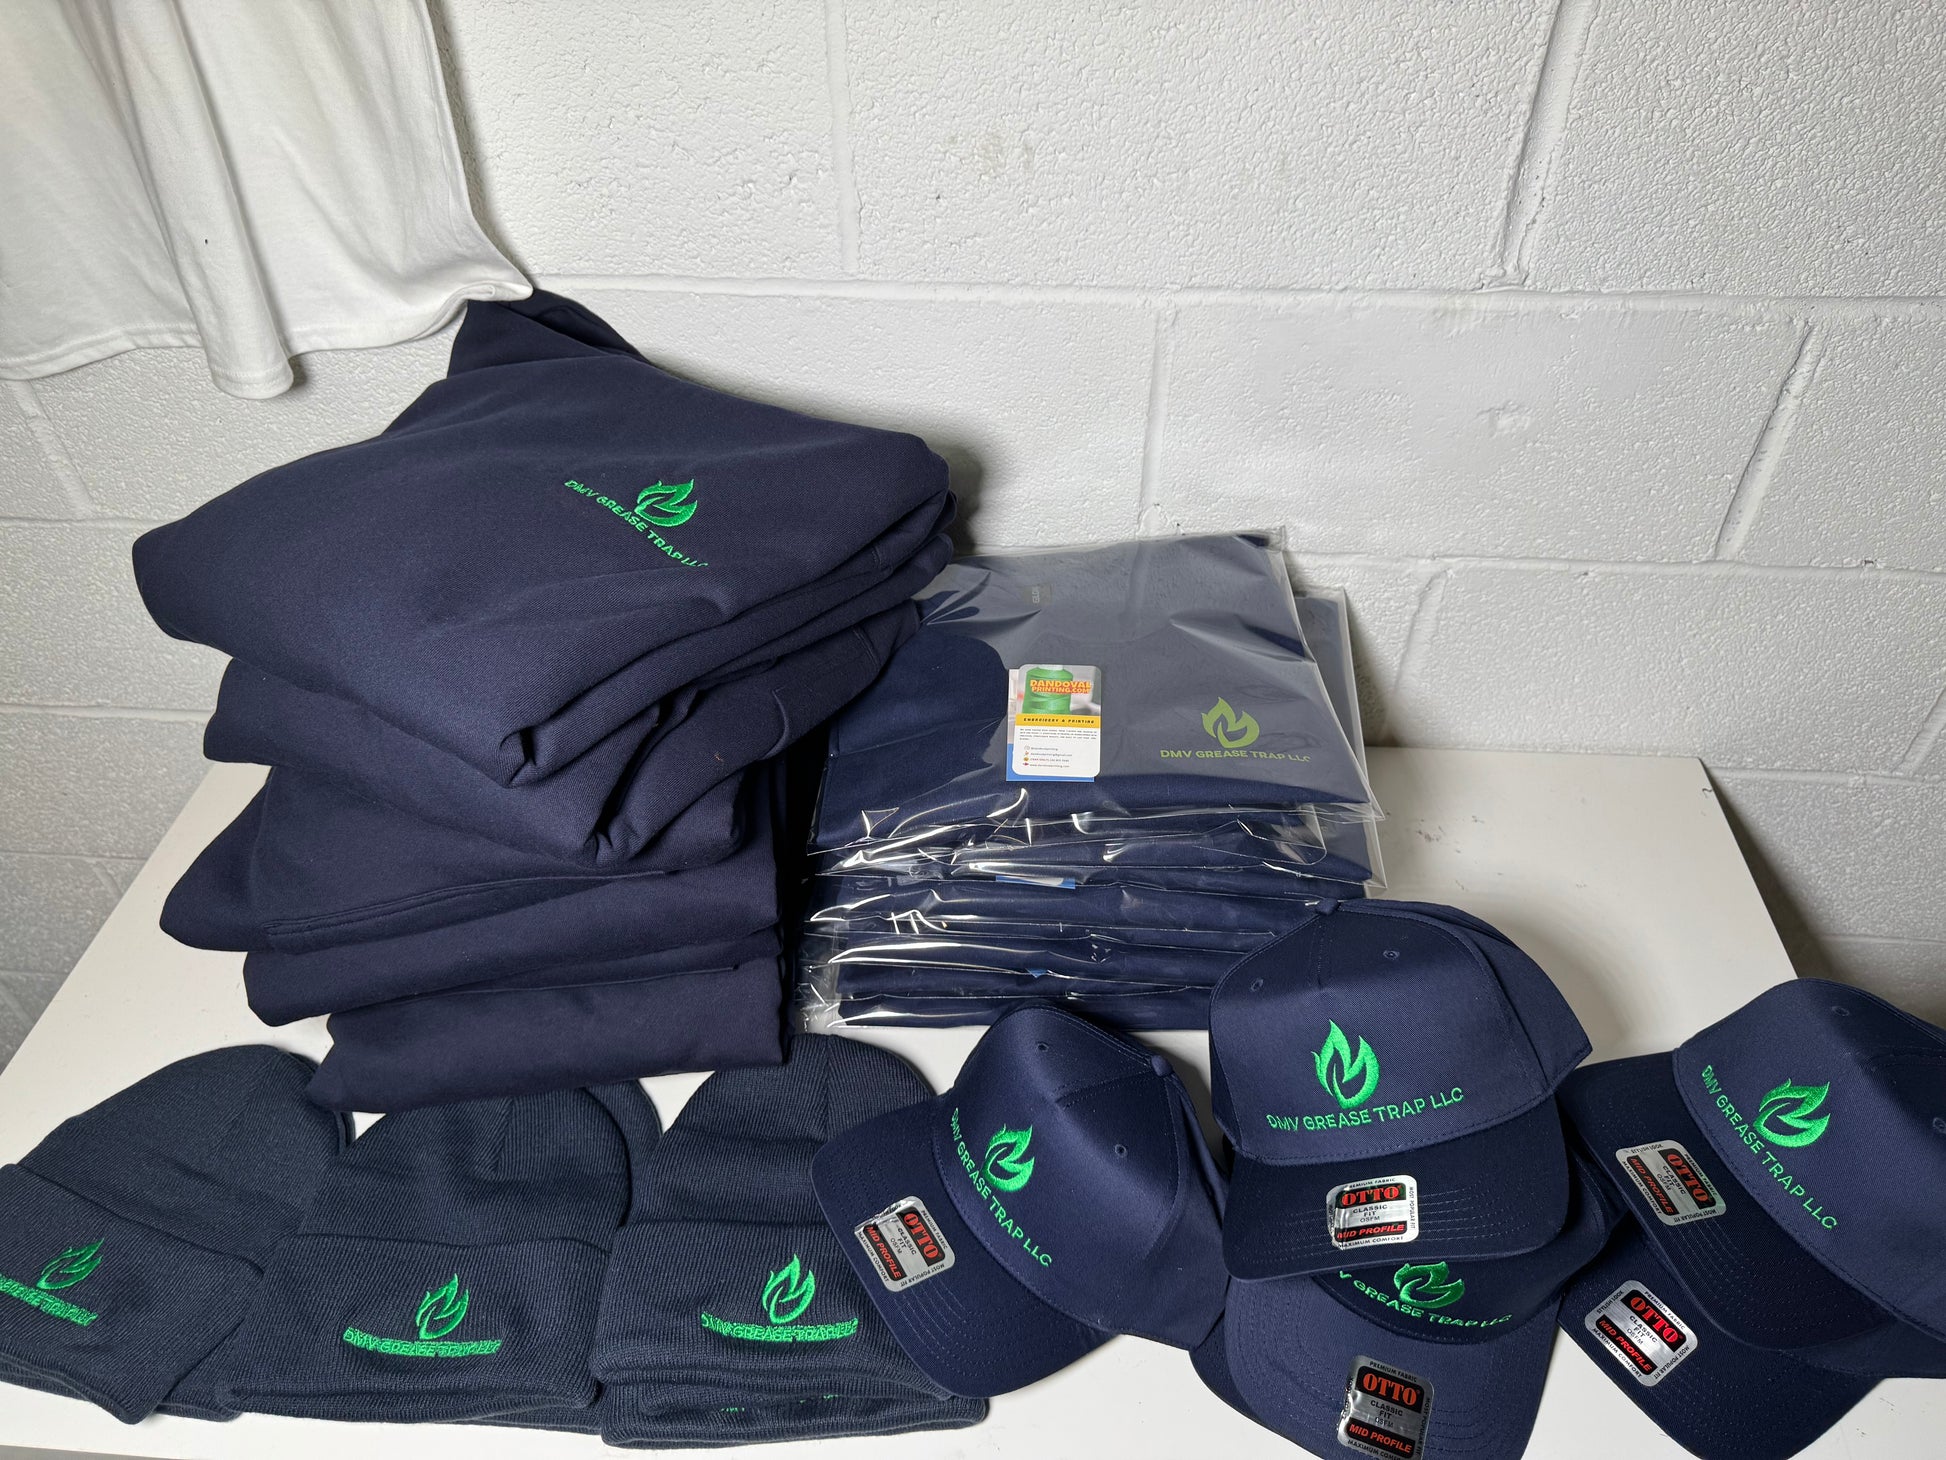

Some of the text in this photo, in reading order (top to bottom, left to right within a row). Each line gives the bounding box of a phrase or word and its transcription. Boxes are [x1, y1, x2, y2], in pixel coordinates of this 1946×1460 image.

[564, 480, 599, 498] DMV
[596, 496, 648, 532] GREASE
[647, 530, 683, 560] TRAP
[1031, 686, 1091, 694] PRINTING.COM
[1160, 750, 1192, 758] DMV
[1195, 750, 1248, 759] GREASE
[1250, 751, 1286, 760] TRAP
[1266, 1087, 1464, 1131] DMV GREASE TRAP LLC
[1701, 1064, 1838, 1230] DMV GREASE TRAP LLC
[1622, 1161, 1662, 1214] MAXIMUM COMFORT
[1630, 1158, 1674, 1213] MID PROFILE
[1656, 1173, 1671, 1191] OSFM
[1663, 1165, 1686, 1195] CLASSIC
[1664, 1176, 1676, 1187] FIT
[1667, 1154, 1709, 1202] OTTO
[1684, 1153, 1718, 1196] PREMIUM FABRIC
[957, 1141, 992, 1199] GREASE
[989, 1195, 1024, 1239] TRAP
[1023, 1238, 1052, 1267] LLC
[1341, 1186, 1399, 1206] OTTO
[1352, 1204, 1388, 1214] CLASSIC
[897, 1227, 917, 1255] CLASSIC
[897, 1238, 907, 1249] FIT
[904, 1213, 939, 1258] OTTO
[921, 1209, 948, 1250] PREMIUM FABRIC
[1359, 1224, 1405, 1235] PROFILE
[858, 1231, 890, 1282] MAXIMUM COMFORT
[865, 1226, 881, 1242] MID
[876, 1242, 902, 1279] PROFILE
[890, 1237, 903, 1254] OSFM
[908, 1270, 931, 1284] POPULAR
[931, 1263, 945, 1273] MOST
[1353, 1279, 1425, 1318] GREASE
[1428, 1312, 1479, 1327] TRAP
[1596, 1290, 1624, 1314] STYLISH LOOK
[1644, 1291, 1686, 1330] PREMIUM FABRIC
[1629, 1315, 1658, 1343] CLASSIC
[1630, 1297, 1678, 1343] OTTO
[1633, 1326, 1645, 1337] FIT
[343, 1327, 379, 1350] DMV
[1599, 1320, 1653, 1372] MID PROFILE
[1626, 1328, 1644, 1345] OSFM
[1592, 1328, 1642, 1378] MAXIMUM COMFORT
[1653, 1346, 1690, 1380] MOST POPULAR FIT
[1369, 1361, 1417, 1382] PREMIUM FABRIC
[1363, 1373, 1416, 1405] OTTO
[1370, 1400, 1403, 1416] CLASSIC
[1380, 1410, 1392, 1419] FIT
[1375, 1417, 1394, 1428] OSFM
[1348, 1439, 1379, 1455] MAXIMUM
[1349, 1424, 1412, 1453] MID PROFILE
